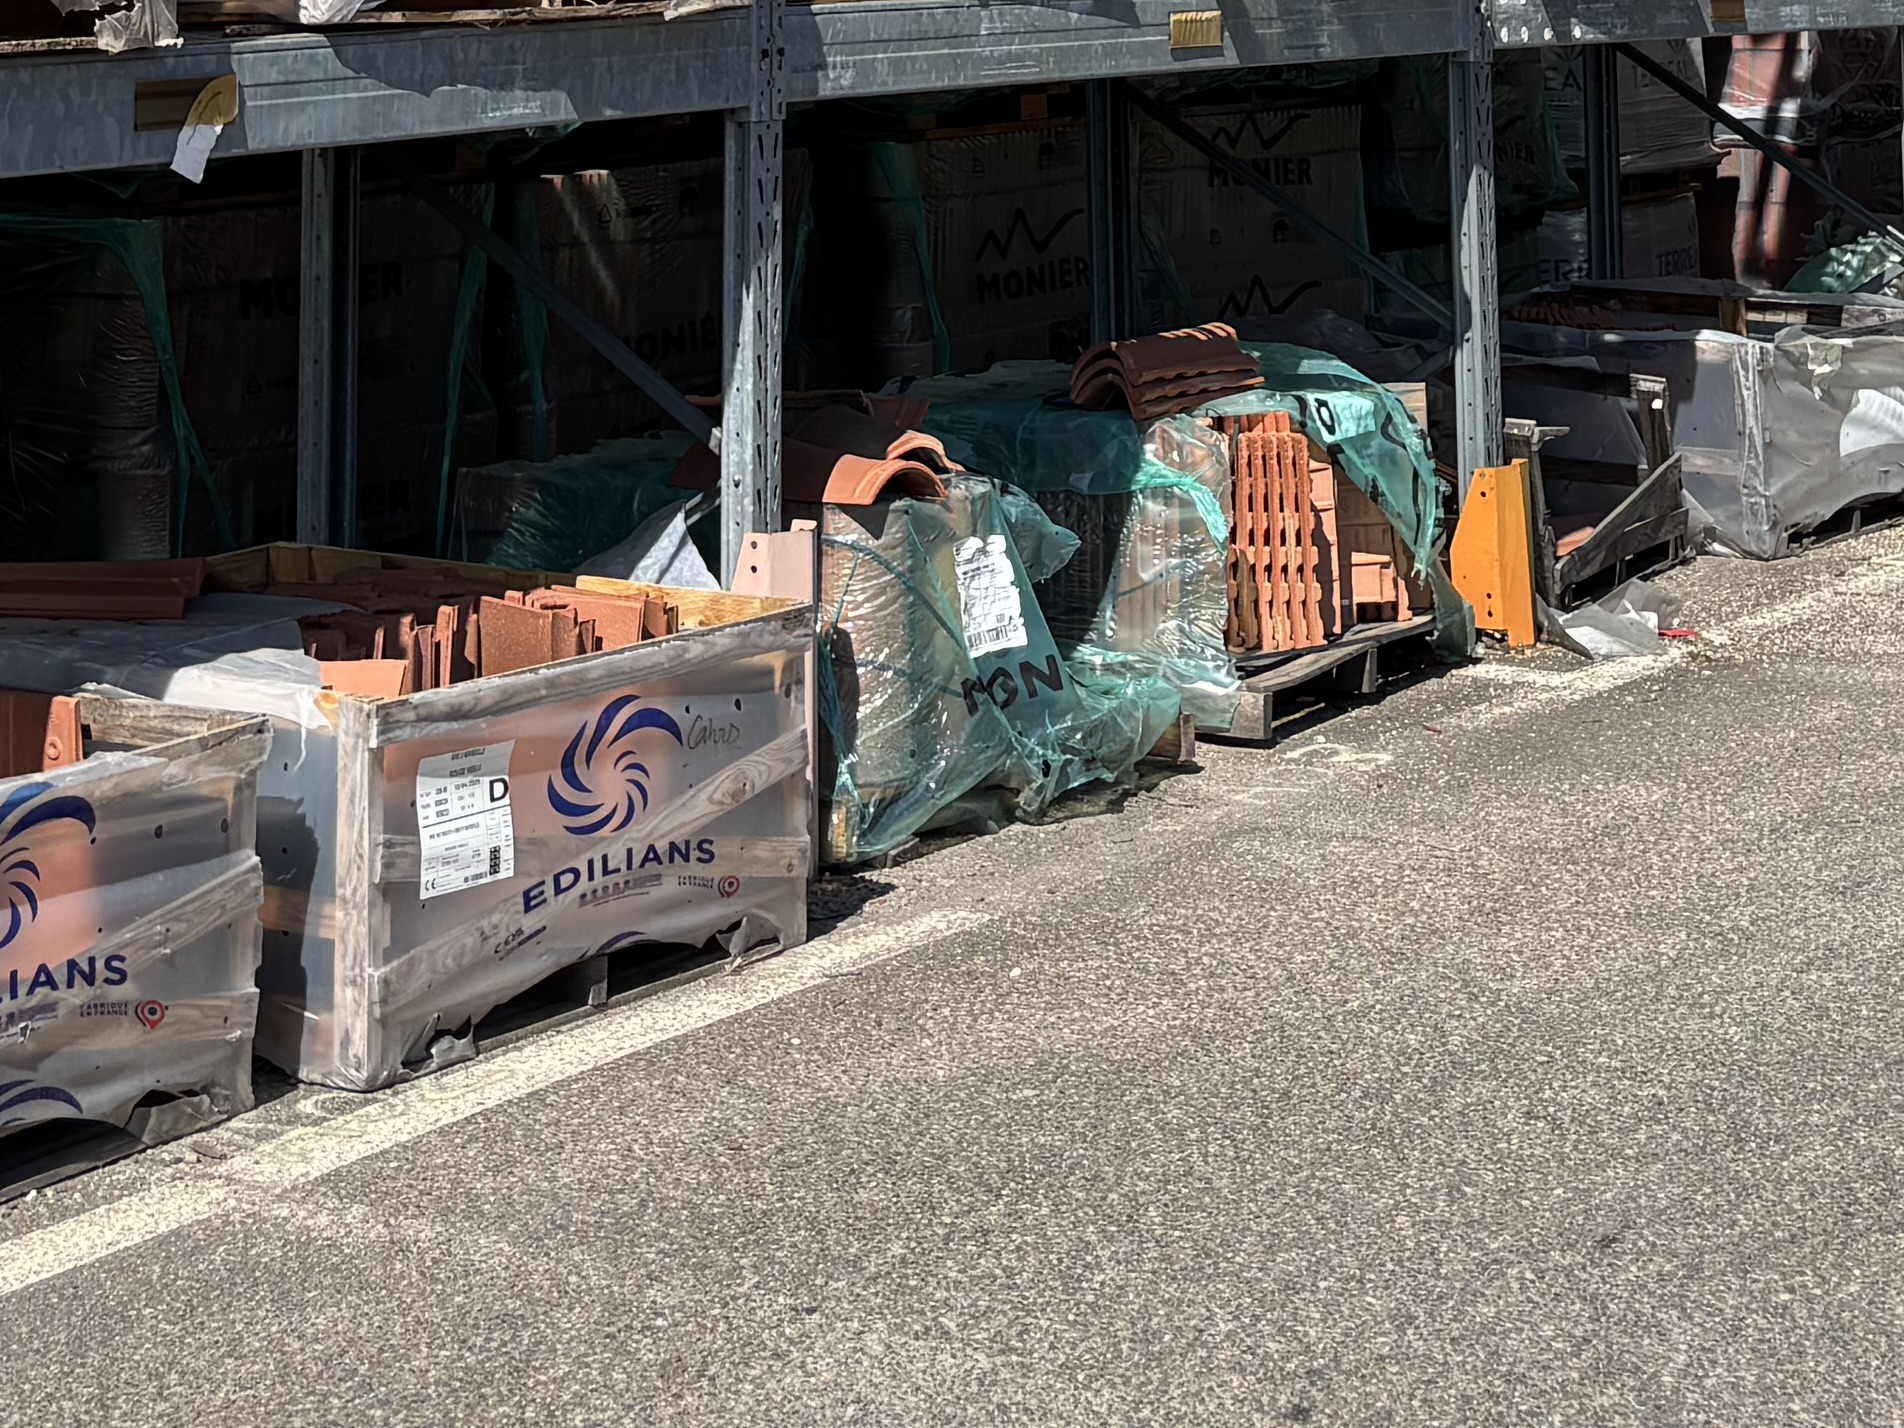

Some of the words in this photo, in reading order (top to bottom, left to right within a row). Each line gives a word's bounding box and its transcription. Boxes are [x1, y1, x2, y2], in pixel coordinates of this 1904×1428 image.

[1208, 157, 1313, 187] MNIER
[976, 256, 1091, 303] MONIER
[489, 777, 509, 803] D
[522, 838, 716, 915] EDILIANS
